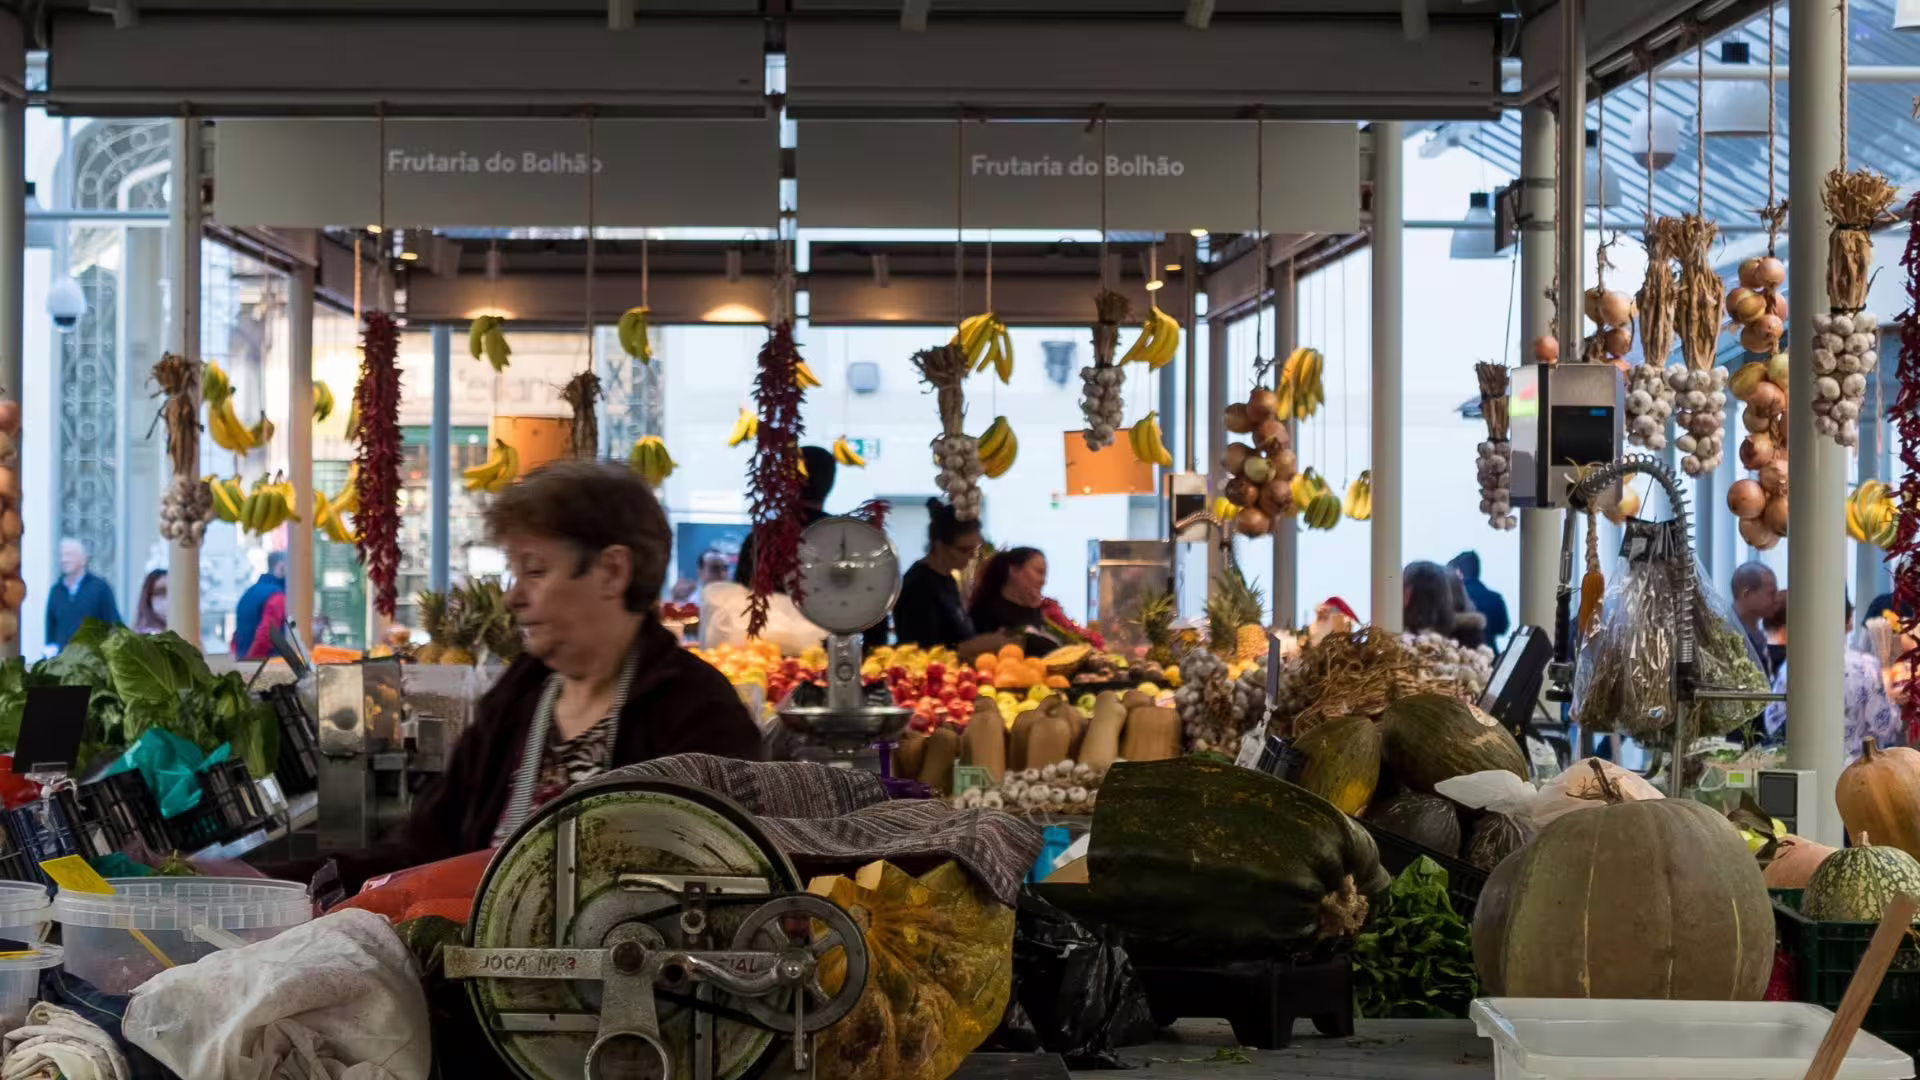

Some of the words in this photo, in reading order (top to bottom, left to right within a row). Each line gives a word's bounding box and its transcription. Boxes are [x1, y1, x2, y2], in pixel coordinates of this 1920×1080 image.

[387, 150, 480, 173] Frutaria
[484, 150, 516, 173] do
[522, 150, 603, 174] Bolhão
[971, 153, 1063, 176] Frutaria
[1068, 154, 1099, 176] do
[1104, 154, 1185, 177] Bolhão
[479, 954, 528, 972] JOCA
